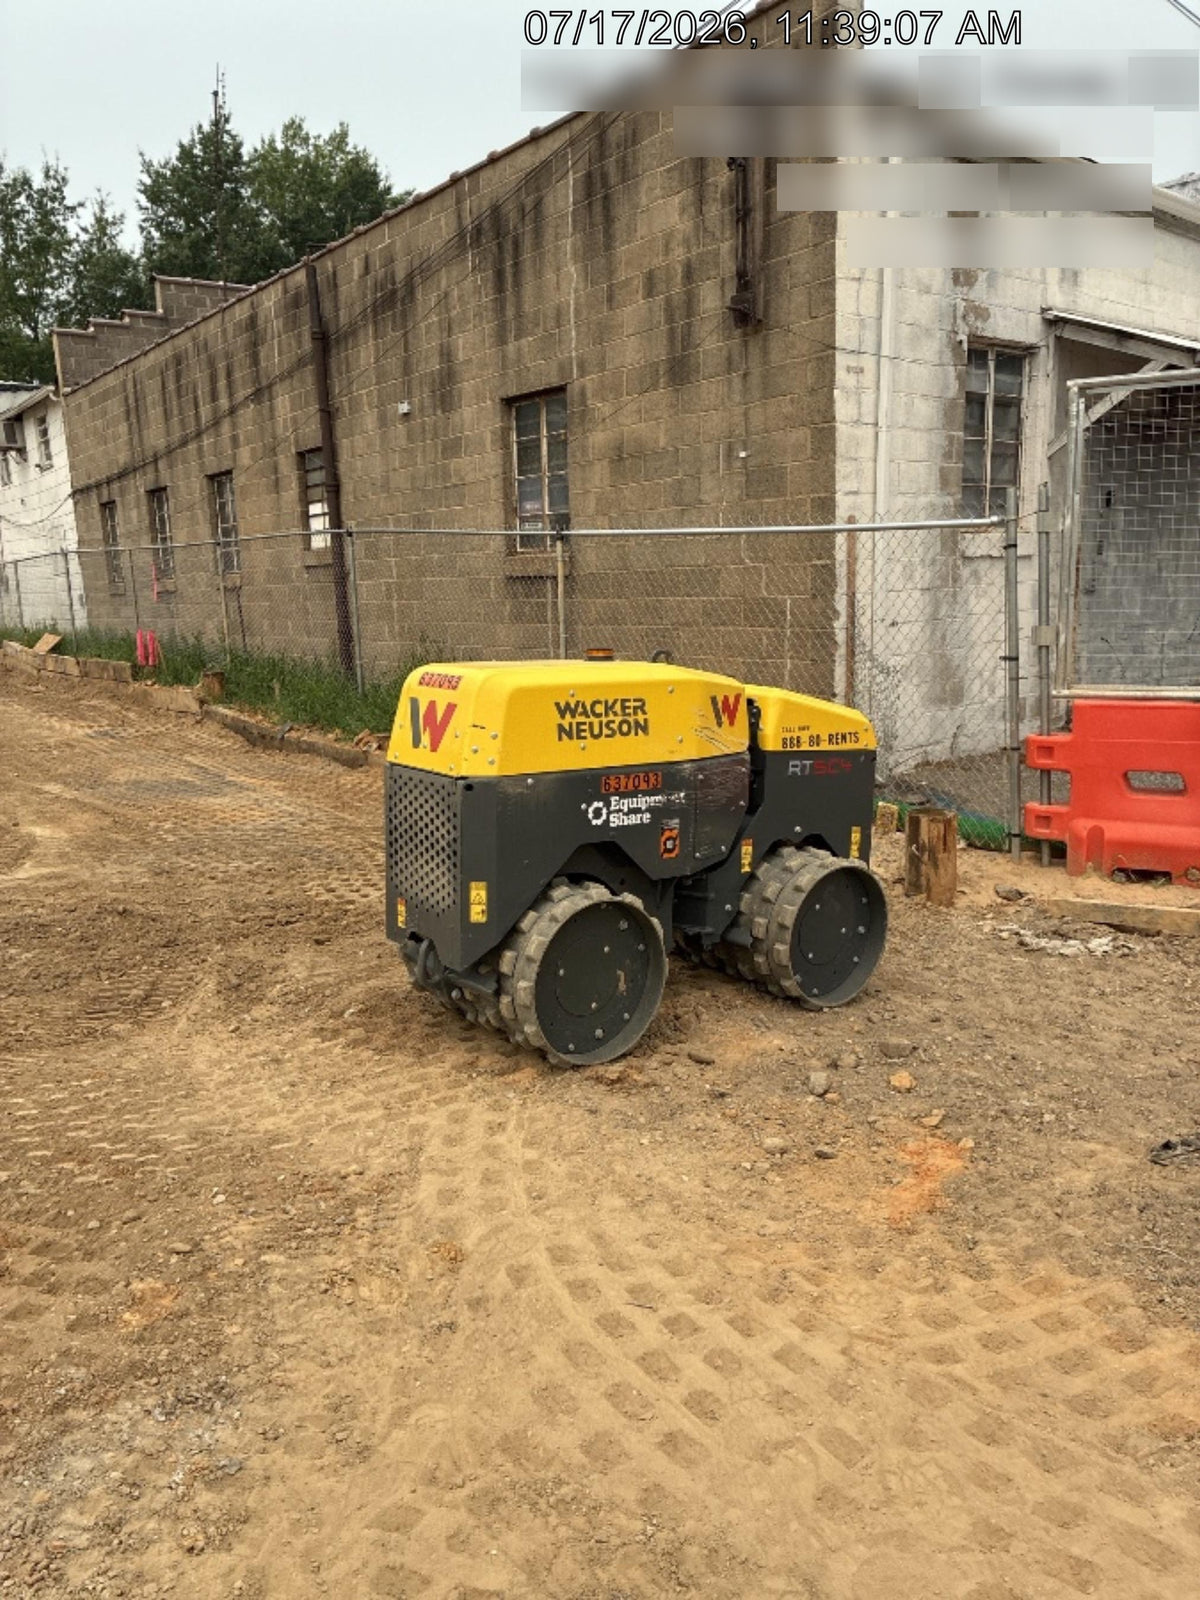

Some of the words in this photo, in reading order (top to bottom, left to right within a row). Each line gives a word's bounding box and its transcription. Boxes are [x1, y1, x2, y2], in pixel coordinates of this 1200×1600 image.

[420, 673, 461, 690] 637093
[554, 698, 648, 719] WACKER
[557, 718, 649, 741] NEUSON
[603, 773, 660, 792] 637093
[610, 812, 651, 827] Share
